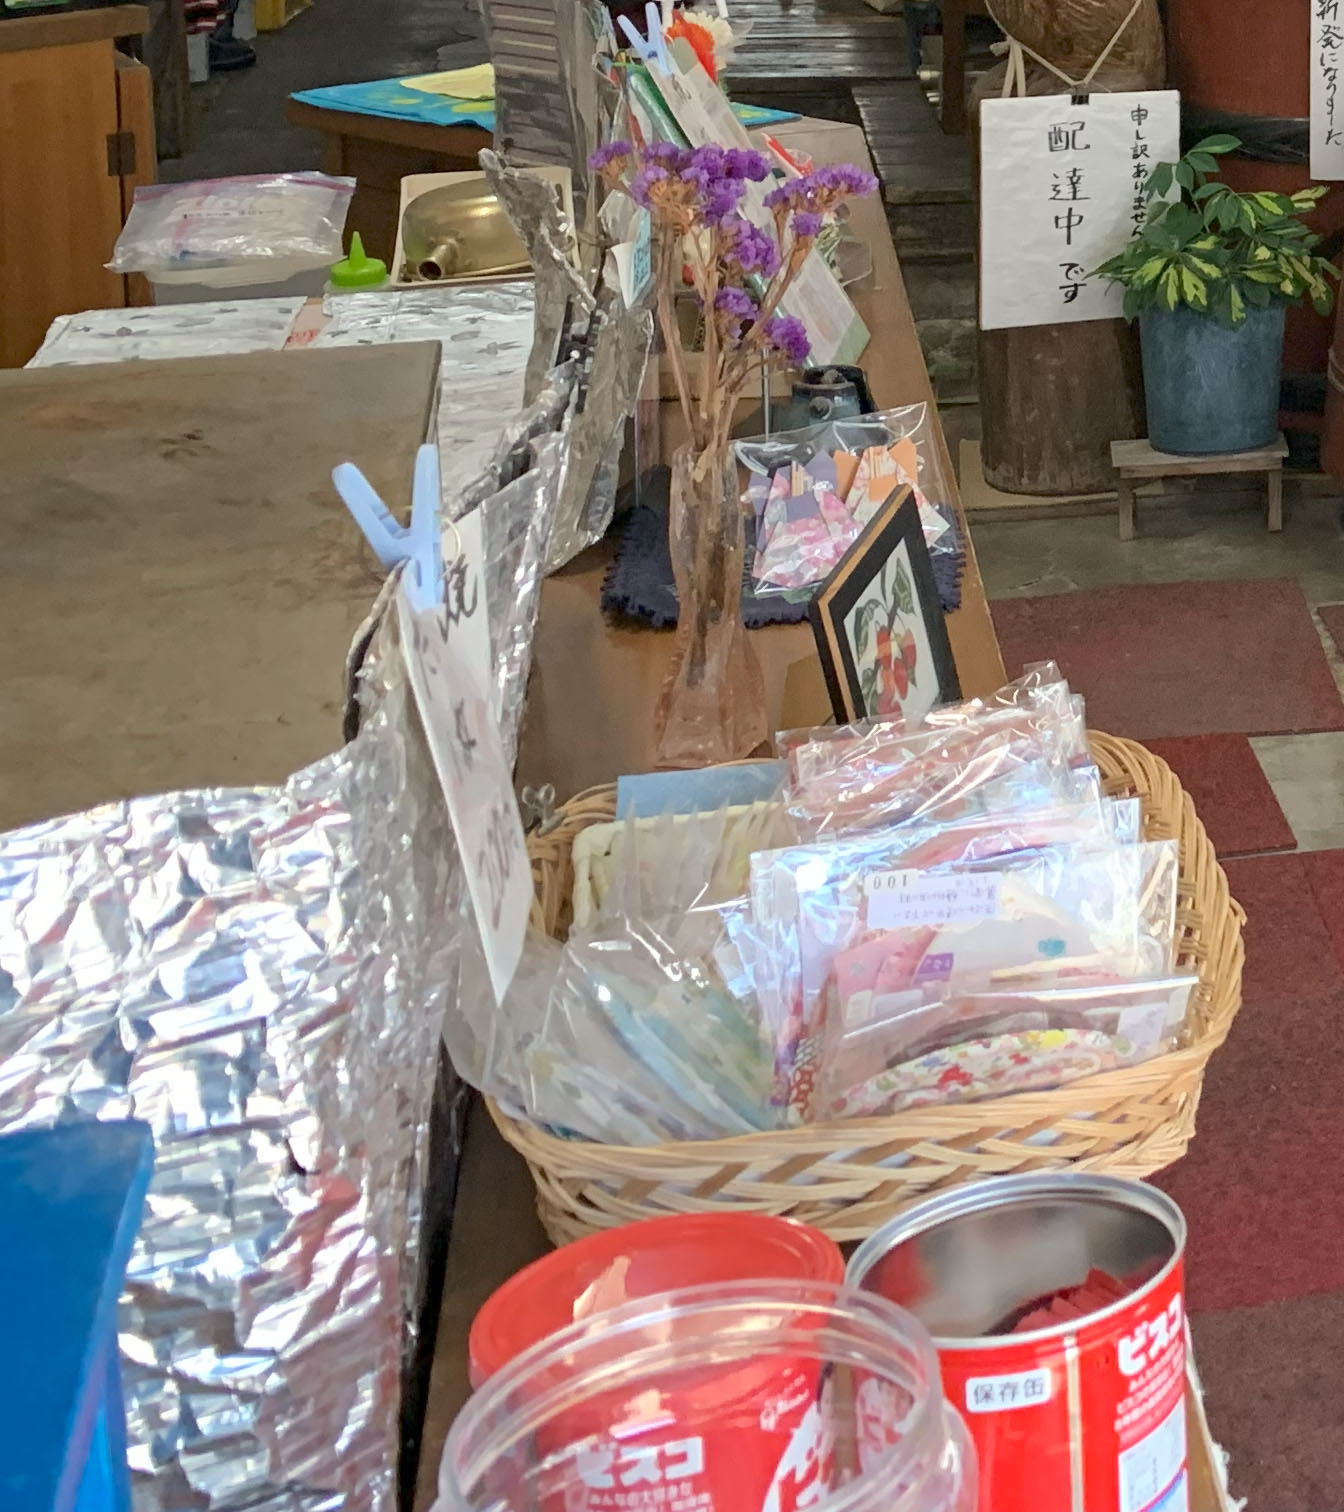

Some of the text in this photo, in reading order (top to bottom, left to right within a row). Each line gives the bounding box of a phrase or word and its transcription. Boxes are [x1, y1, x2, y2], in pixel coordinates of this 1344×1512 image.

[1047, 120, 1092, 304] 配達中です
[1128, 103, 1150, 238] 申し訳ありません
[973, 1376, 1045, 1405] 保存缶
